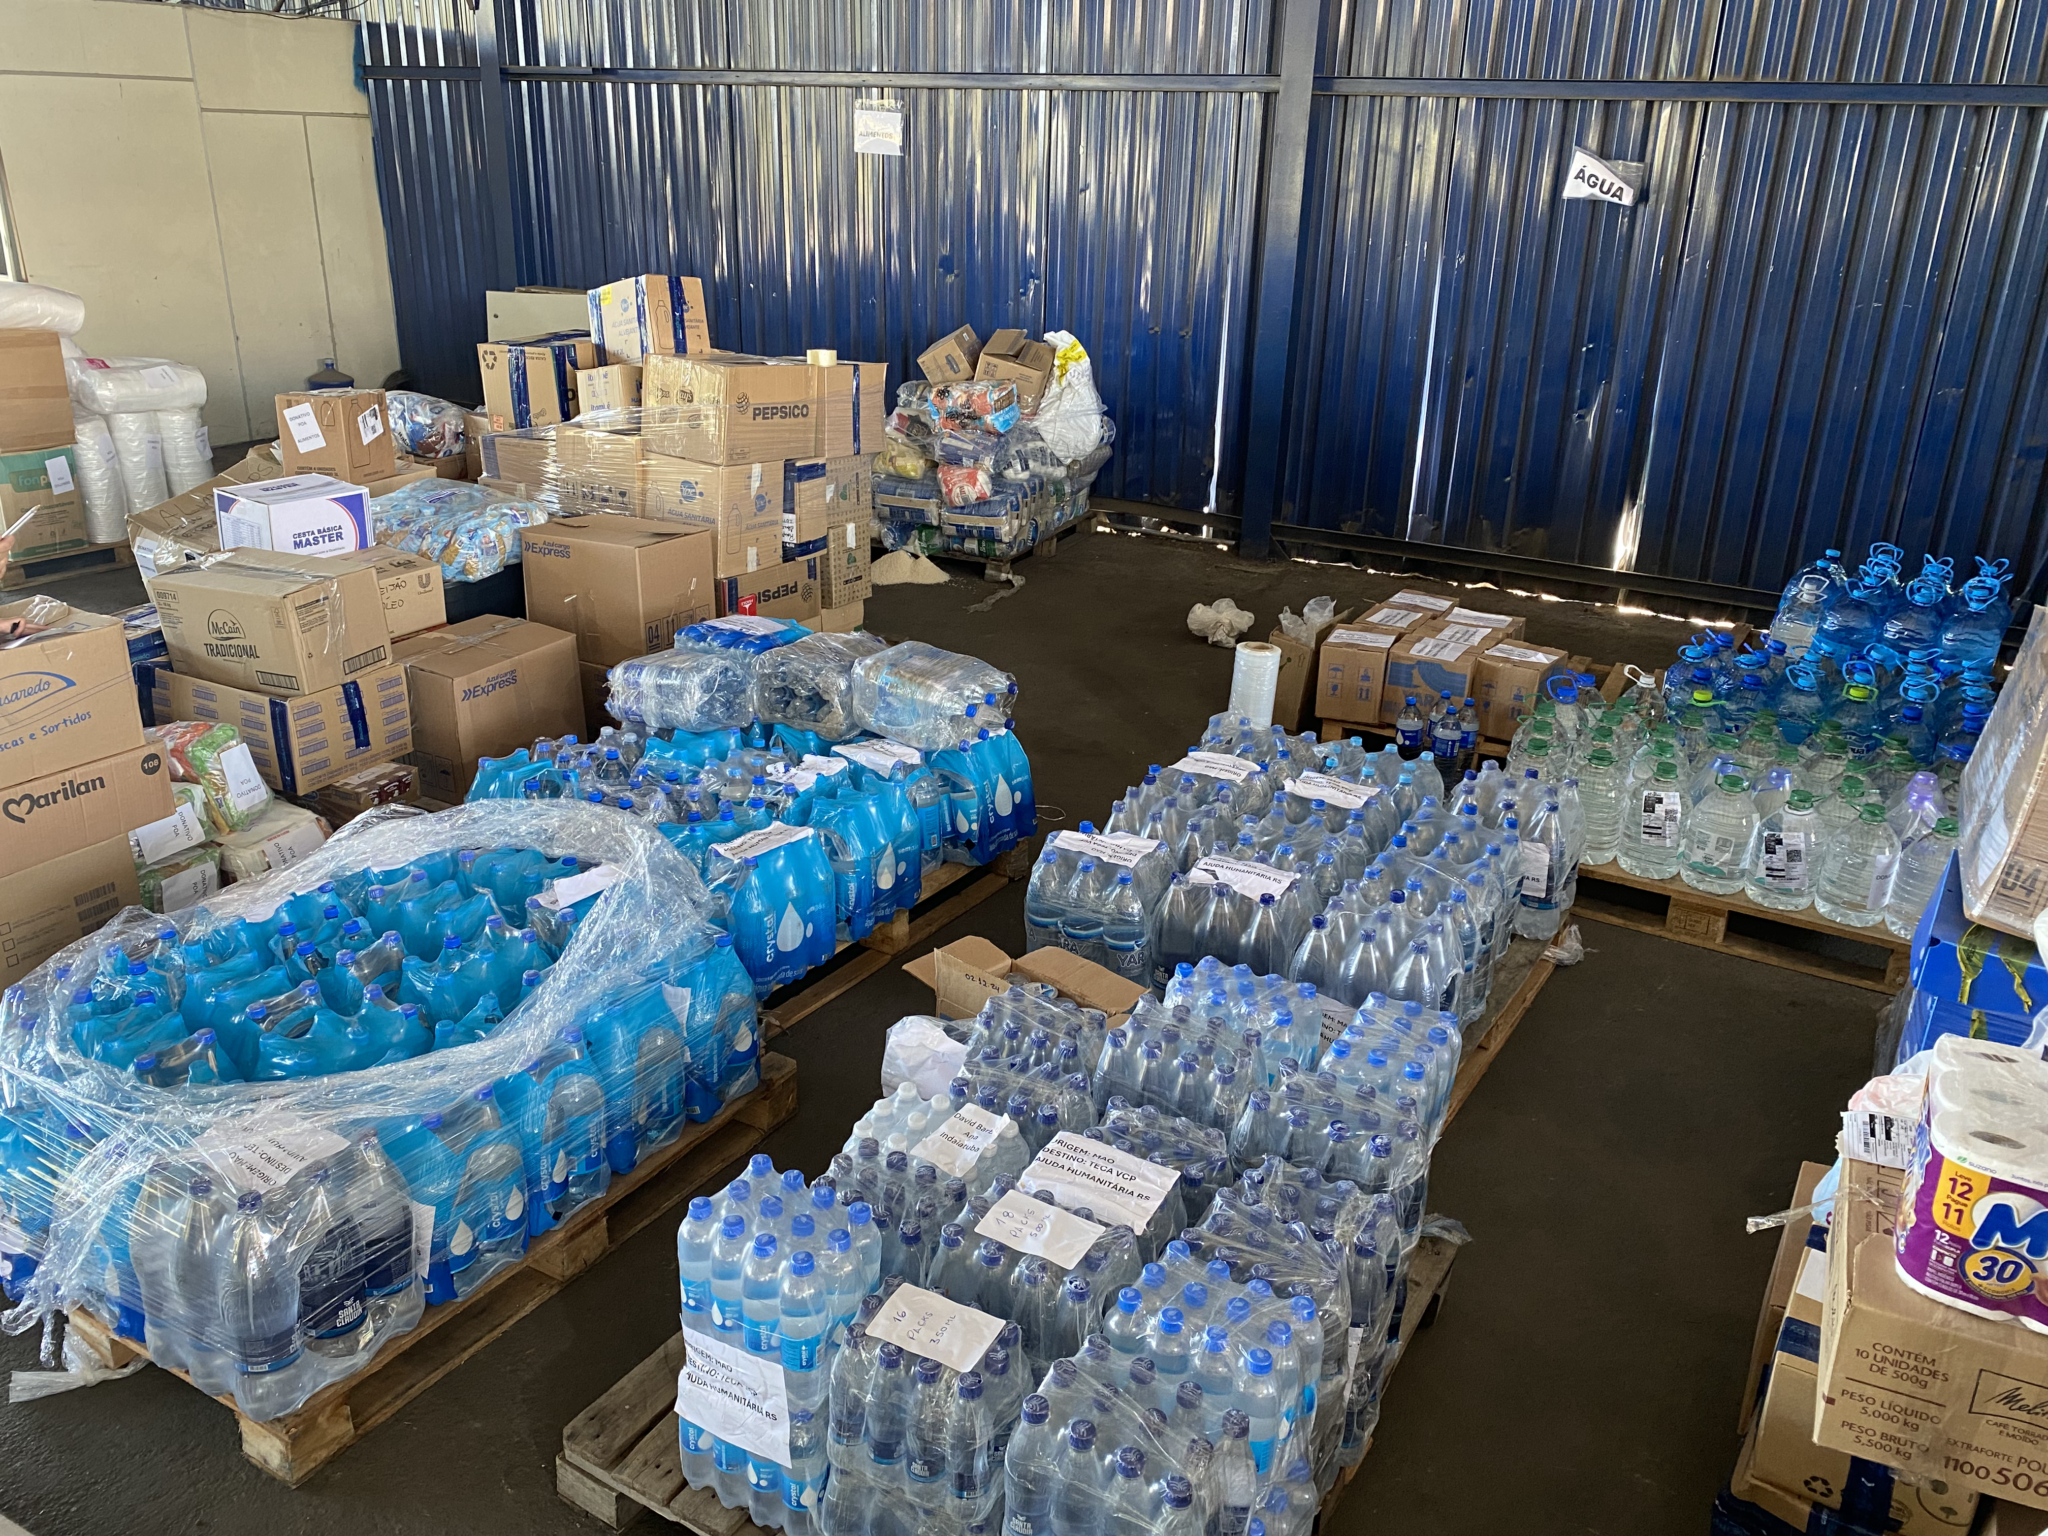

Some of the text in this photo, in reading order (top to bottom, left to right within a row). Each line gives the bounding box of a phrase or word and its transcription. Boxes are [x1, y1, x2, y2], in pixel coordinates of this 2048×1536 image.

[1573, 165, 1624, 202] ÁGUA
[289, 411, 310, 422] DONATIVO
[752, 404, 810, 421] PEPSICO
[18, 475, 48, 488] fonp
[667, 508, 716, 525] ÁGUA SANITÁRIA
[292, 524, 343, 540] CESTA BÁSICA
[293, 532, 344, 550] MASTER
[531, 543, 571, 560] Express
[156, 591, 177, 601] 009714
[757, 580, 798, 605] PEPSI
[211, 620, 242, 635] McCain
[648, 623, 660, 644] 04
[204, 643, 260, 659] TRADICIONAL
[472, 673, 518, 700] Express
[29, 732, 37, 740] e
[40, 710, 92, 737] Sortidos
[143, 758, 160, 769] 108
[240, 778, 252, 786] POA
[236, 783, 262, 799] DONATIVO
[2, 776, 106, 824] Marilan
[171, 825, 180, 838] POA
[178, 811, 194, 842] DONATIVO
[288, 846, 297, 859] POA
[1203, 861, 1224, 869] AJUDA
[2001, 860, 2042, 898] 04
[763, 912, 775, 963] crystal
[1117, 951, 1147, 967] YAR
[953, 1112, 976, 1127] David
[963, 1131, 979, 1140] Ana
[1042, 1147, 1137, 1183] DESTINO: TECA VCP
[1092, 1153, 1115, 1164] MAO
[1955, 1171, 1972, 1181] Leve
[1968, 1161, 1997, 1175] suzano
[1035, 1156, 1151, 1202] AJUDA HUMANITÁRIA RS
[1948, 1177, 1974, 1202] 12
[1946, 1194, 1969, 1208] Pague
[1942, 1202, 1965, 1225] 11
[1934, 1229, 1950, 1245] 12
[1970, 1202, 2048, 1260] M
[1972, 1255, 2024, 1284] 30
[338, 1300, 360, 1319] SANTA
[893, 1310, 907, 1323] 16
[907, 1311, 934, 1341] PACKS
[1872, 1342, 1937, 1367] CONTÉM
[715, 1358, 733, 1373] MAO
[1855, 1348, 1949, 1382] 10 UNIDADES
[1869, 1363, 1929, 1390] DE 500g
[765, 1410, 778, 1421] RS
[1841, 1389, 1942, 1425] PESO LÍQUIDO
[1903, 1418, 1920, 1432] kg
[1985, 1419, 2048, 1441] CAFÉ TORRAD
[687, 1426, 695, 1450] crystal
[1841, 1420, 1930, 1453] PESO BRUTO
[2005, 1432, 2040, 1446] MOÍDO
[1853, 1435, 1912, 1461] 5,500 kg
[1947, 1438, 2048, 1476] EXTRAFORTE POU
[1943, 1455, 2048, 1498] 1100 506
[1011, 1516, 1032, 1529] SANTA
